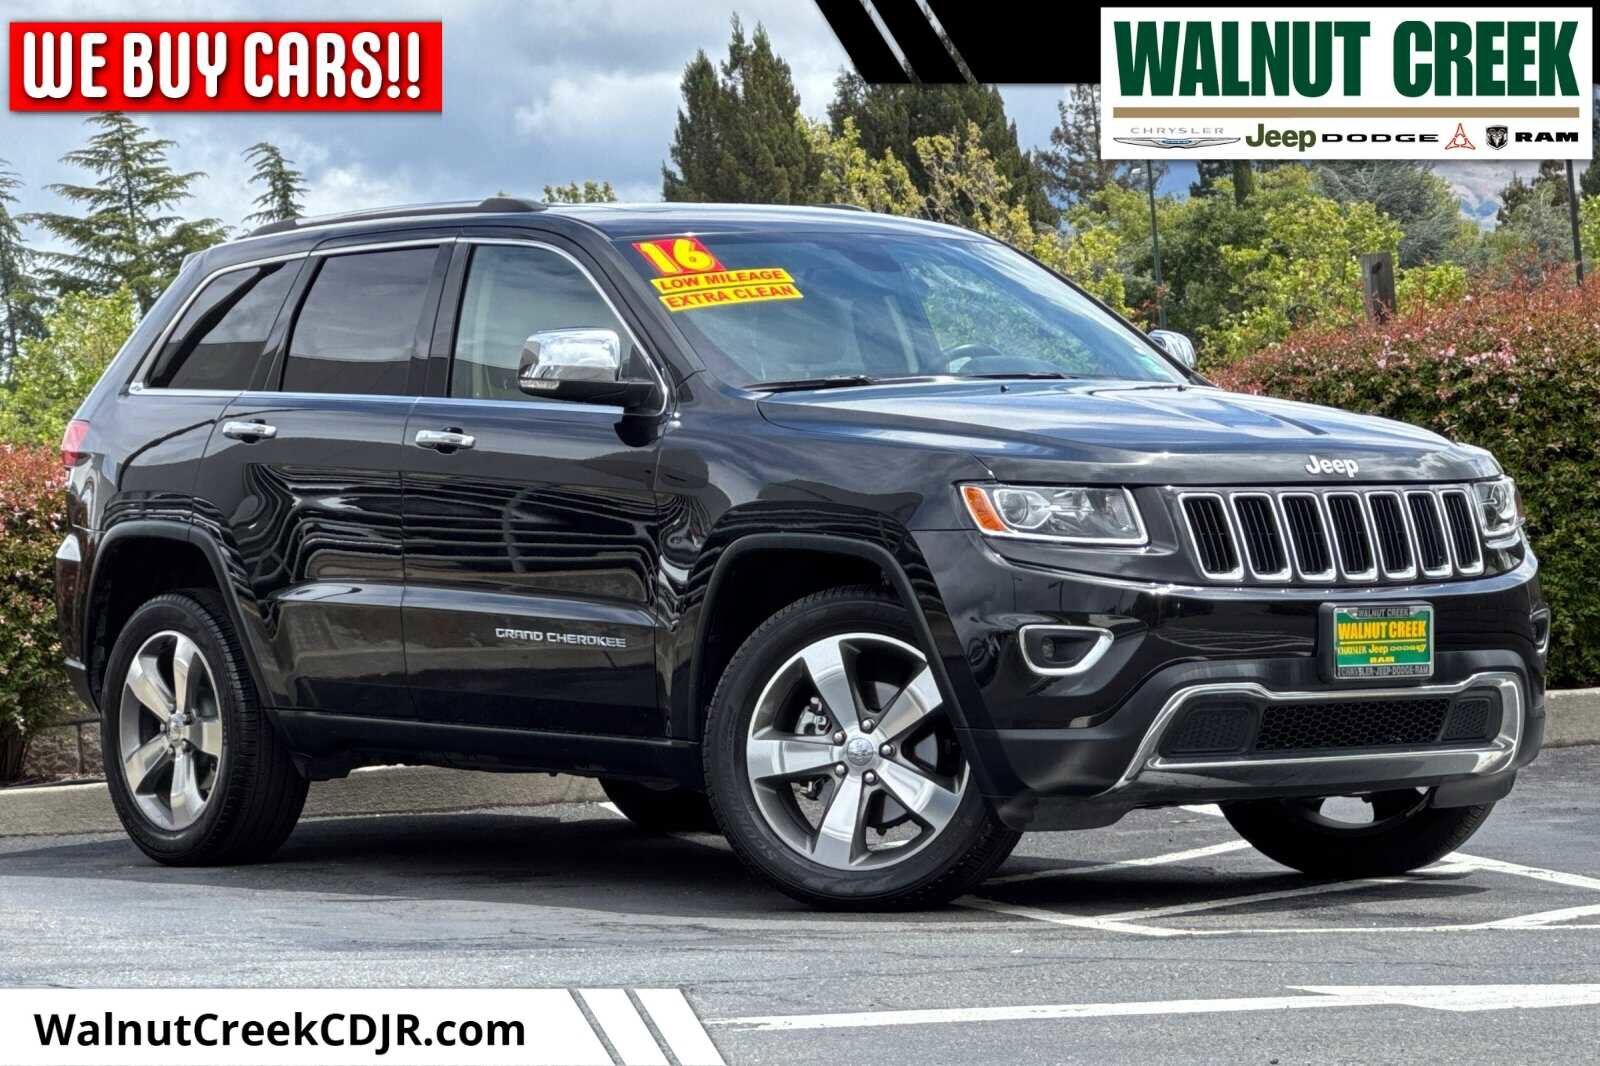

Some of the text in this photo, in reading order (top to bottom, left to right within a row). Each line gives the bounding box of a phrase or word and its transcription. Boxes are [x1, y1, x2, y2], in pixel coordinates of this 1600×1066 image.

[639, 238, 716, 274] 16
[659, 269, 785, 291] LOW MILEAGE
[666, 284, 795, 308] EXTRA CLEAN
[1305, 454, 1359, 478] Jeep
[1357, 607, 1409, 617] WALNUT CREEK
[495, 627, 627, 648] GRAND CHEROKEE
[1338, 620, 1426, 640] WALNUT CREEK
[1368, 644, 1389, 655] Jeep
[1369, 656, 1395, 664] RAM
